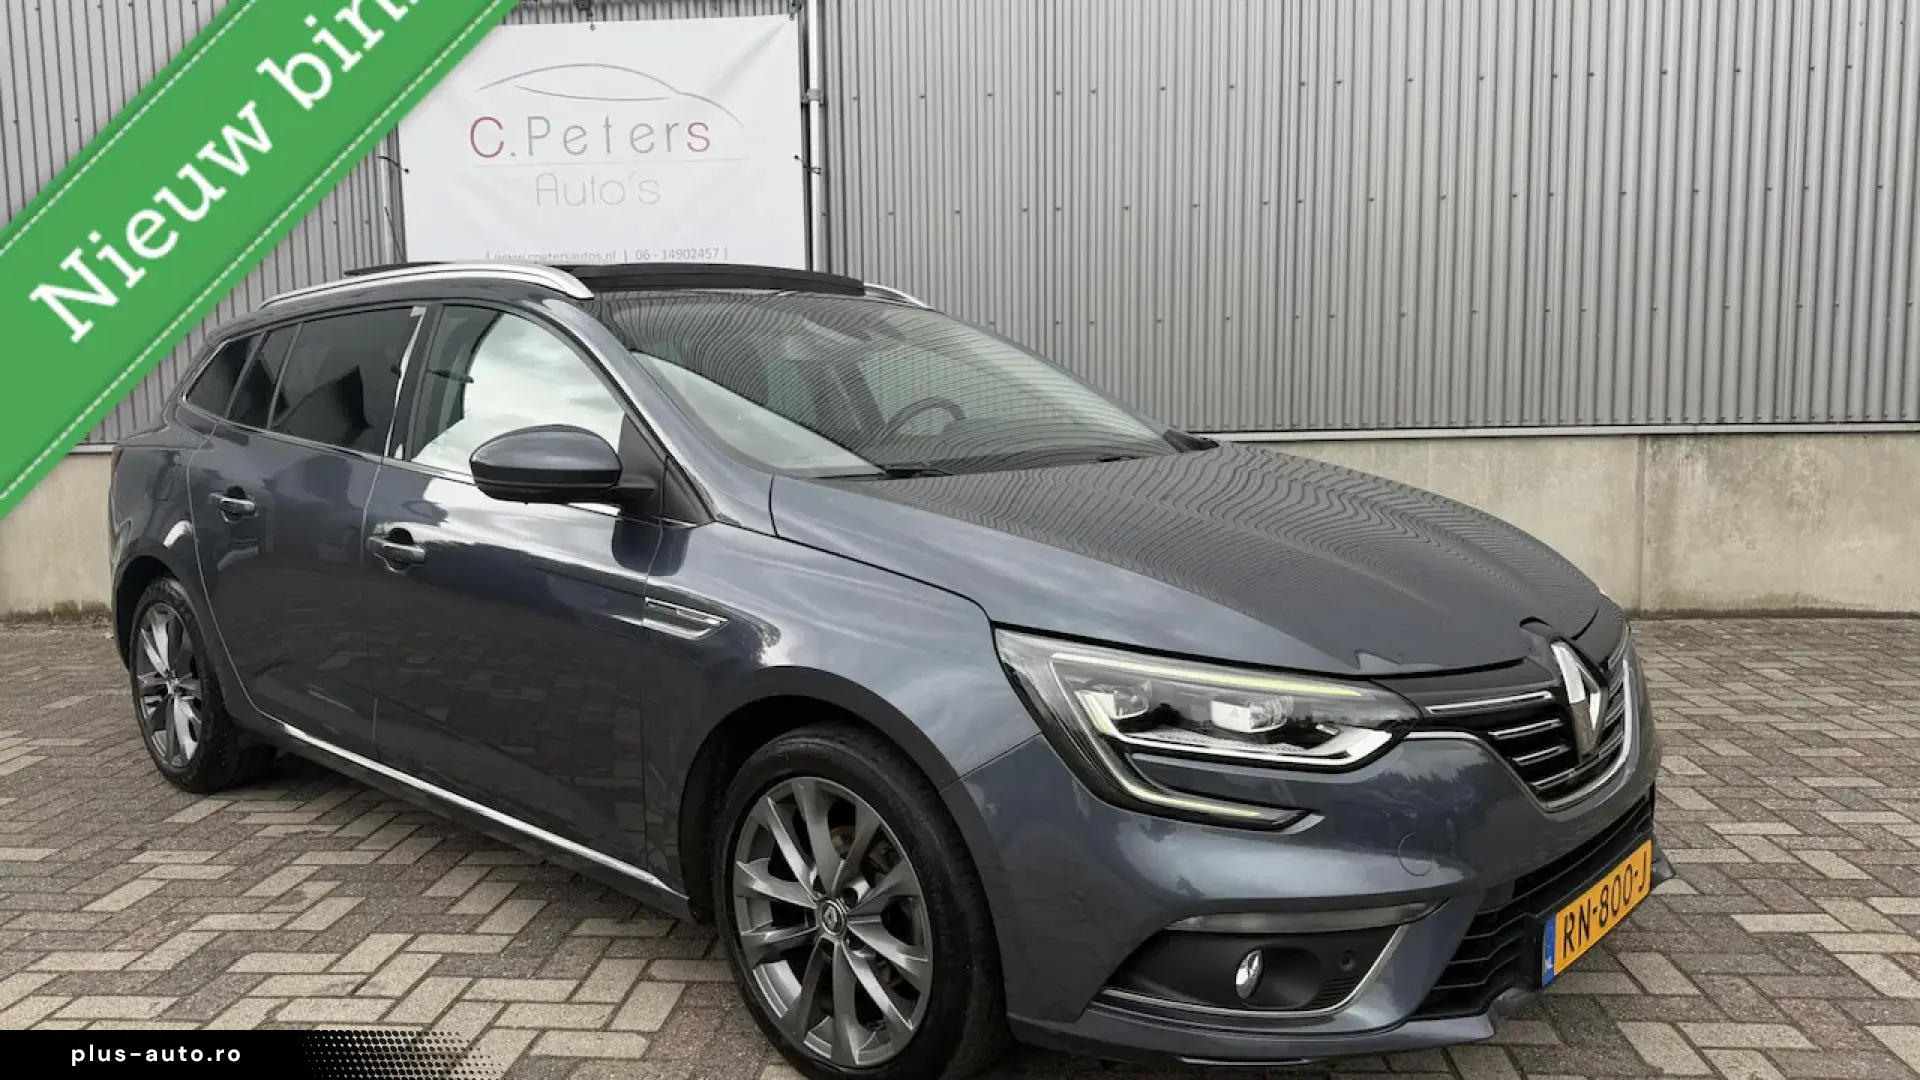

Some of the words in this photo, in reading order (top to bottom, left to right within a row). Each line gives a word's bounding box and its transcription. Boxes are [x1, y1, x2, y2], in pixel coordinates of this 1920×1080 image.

[635, 249, 651, 260] 06
[662, 248, 719, 260] 14902457
[1562, 850, 1648, 959] RN-800-J
